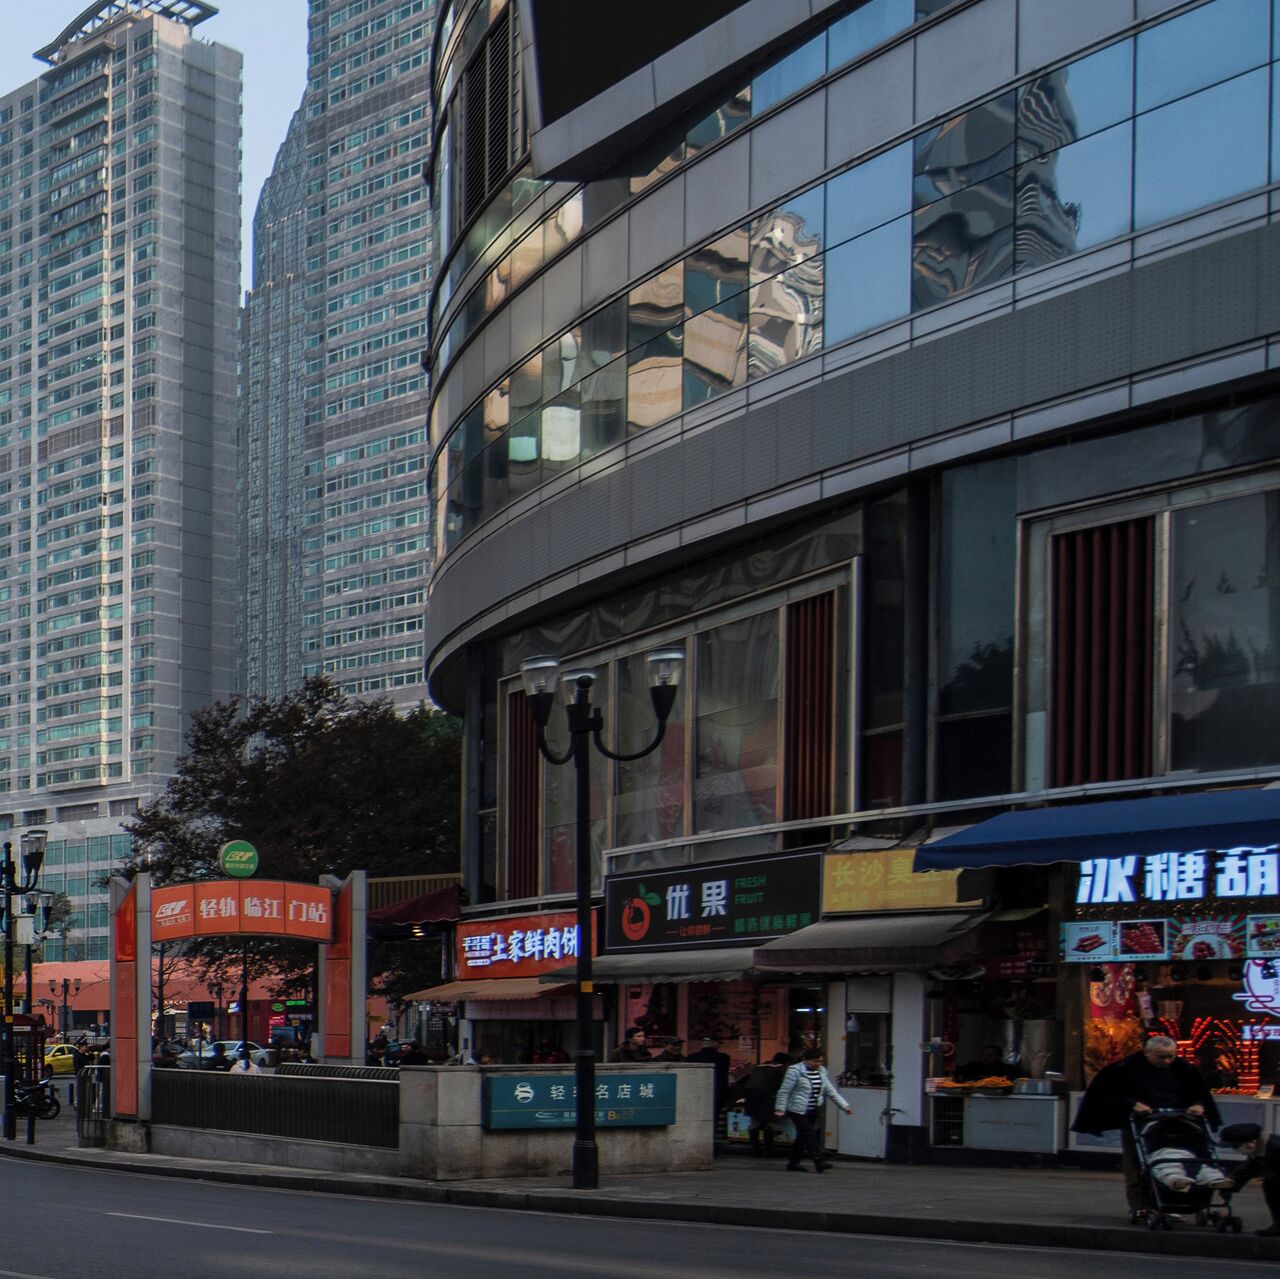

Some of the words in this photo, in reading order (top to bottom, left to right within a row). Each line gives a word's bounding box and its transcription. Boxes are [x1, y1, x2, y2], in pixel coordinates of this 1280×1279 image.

[735, 876, 767, 889] FRESH
[1076, 848, 1280, 904] 冰糖葫
[199, 896, 328, 924] 轻轨临江门站
[665, 879, 728, 921] 优果
[735, 892, 765, 904] FRUIT
